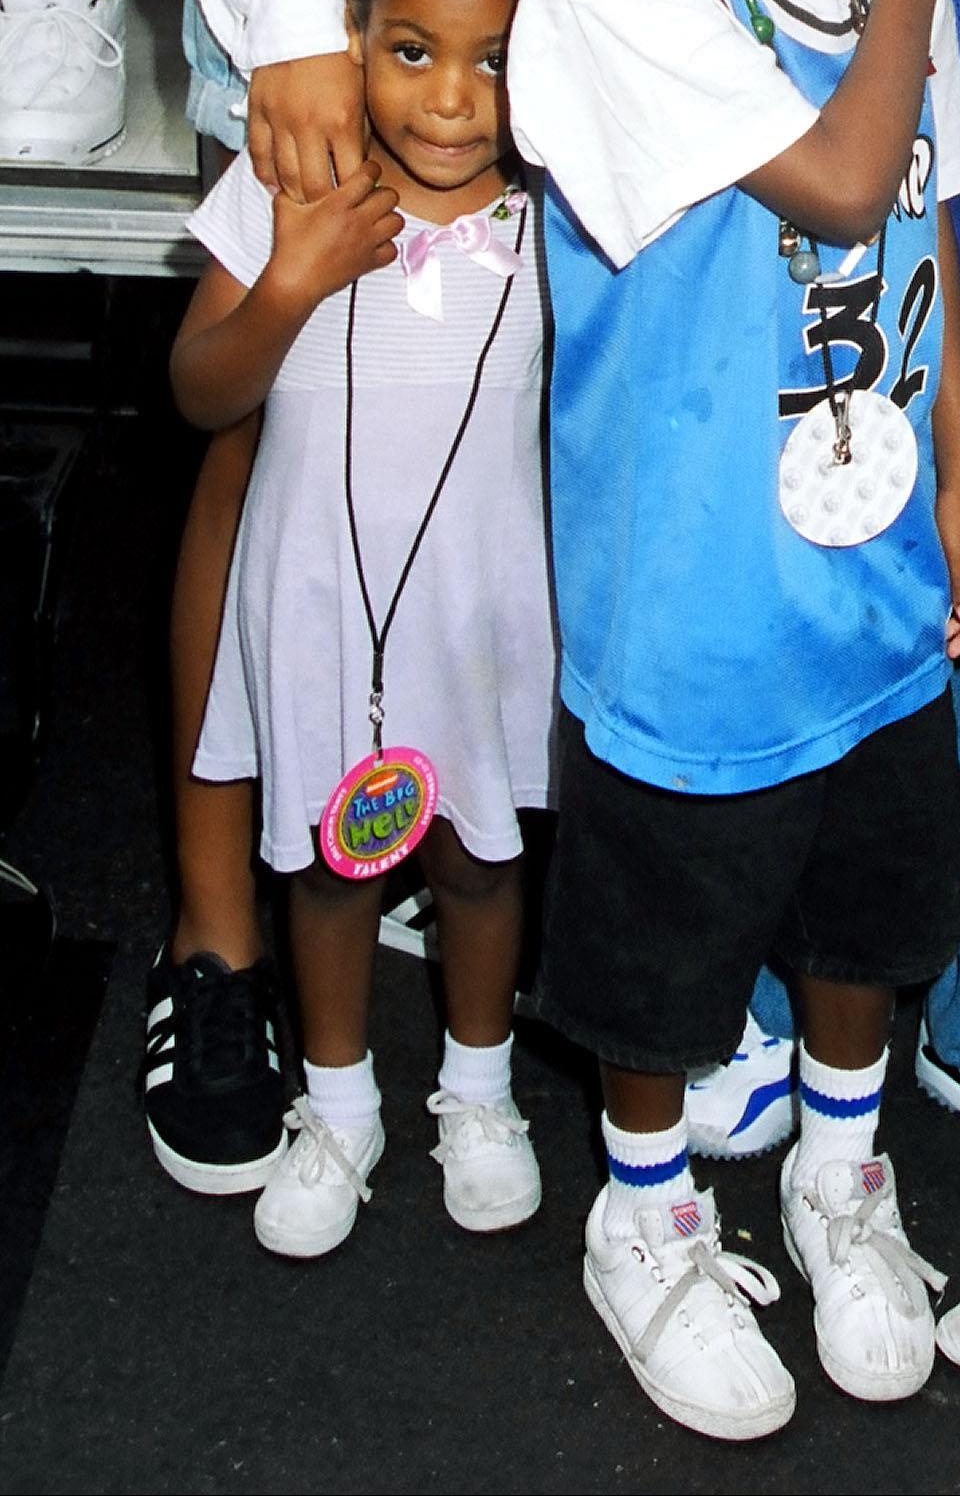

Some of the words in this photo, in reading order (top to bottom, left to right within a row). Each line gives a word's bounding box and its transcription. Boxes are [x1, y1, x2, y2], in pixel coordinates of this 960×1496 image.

[778, 254, 937, 420] 32
[353, 796, 380, 819] THE
[384, 780, 415, 807] BIG
[353, 842, 408, 876] TALENT
